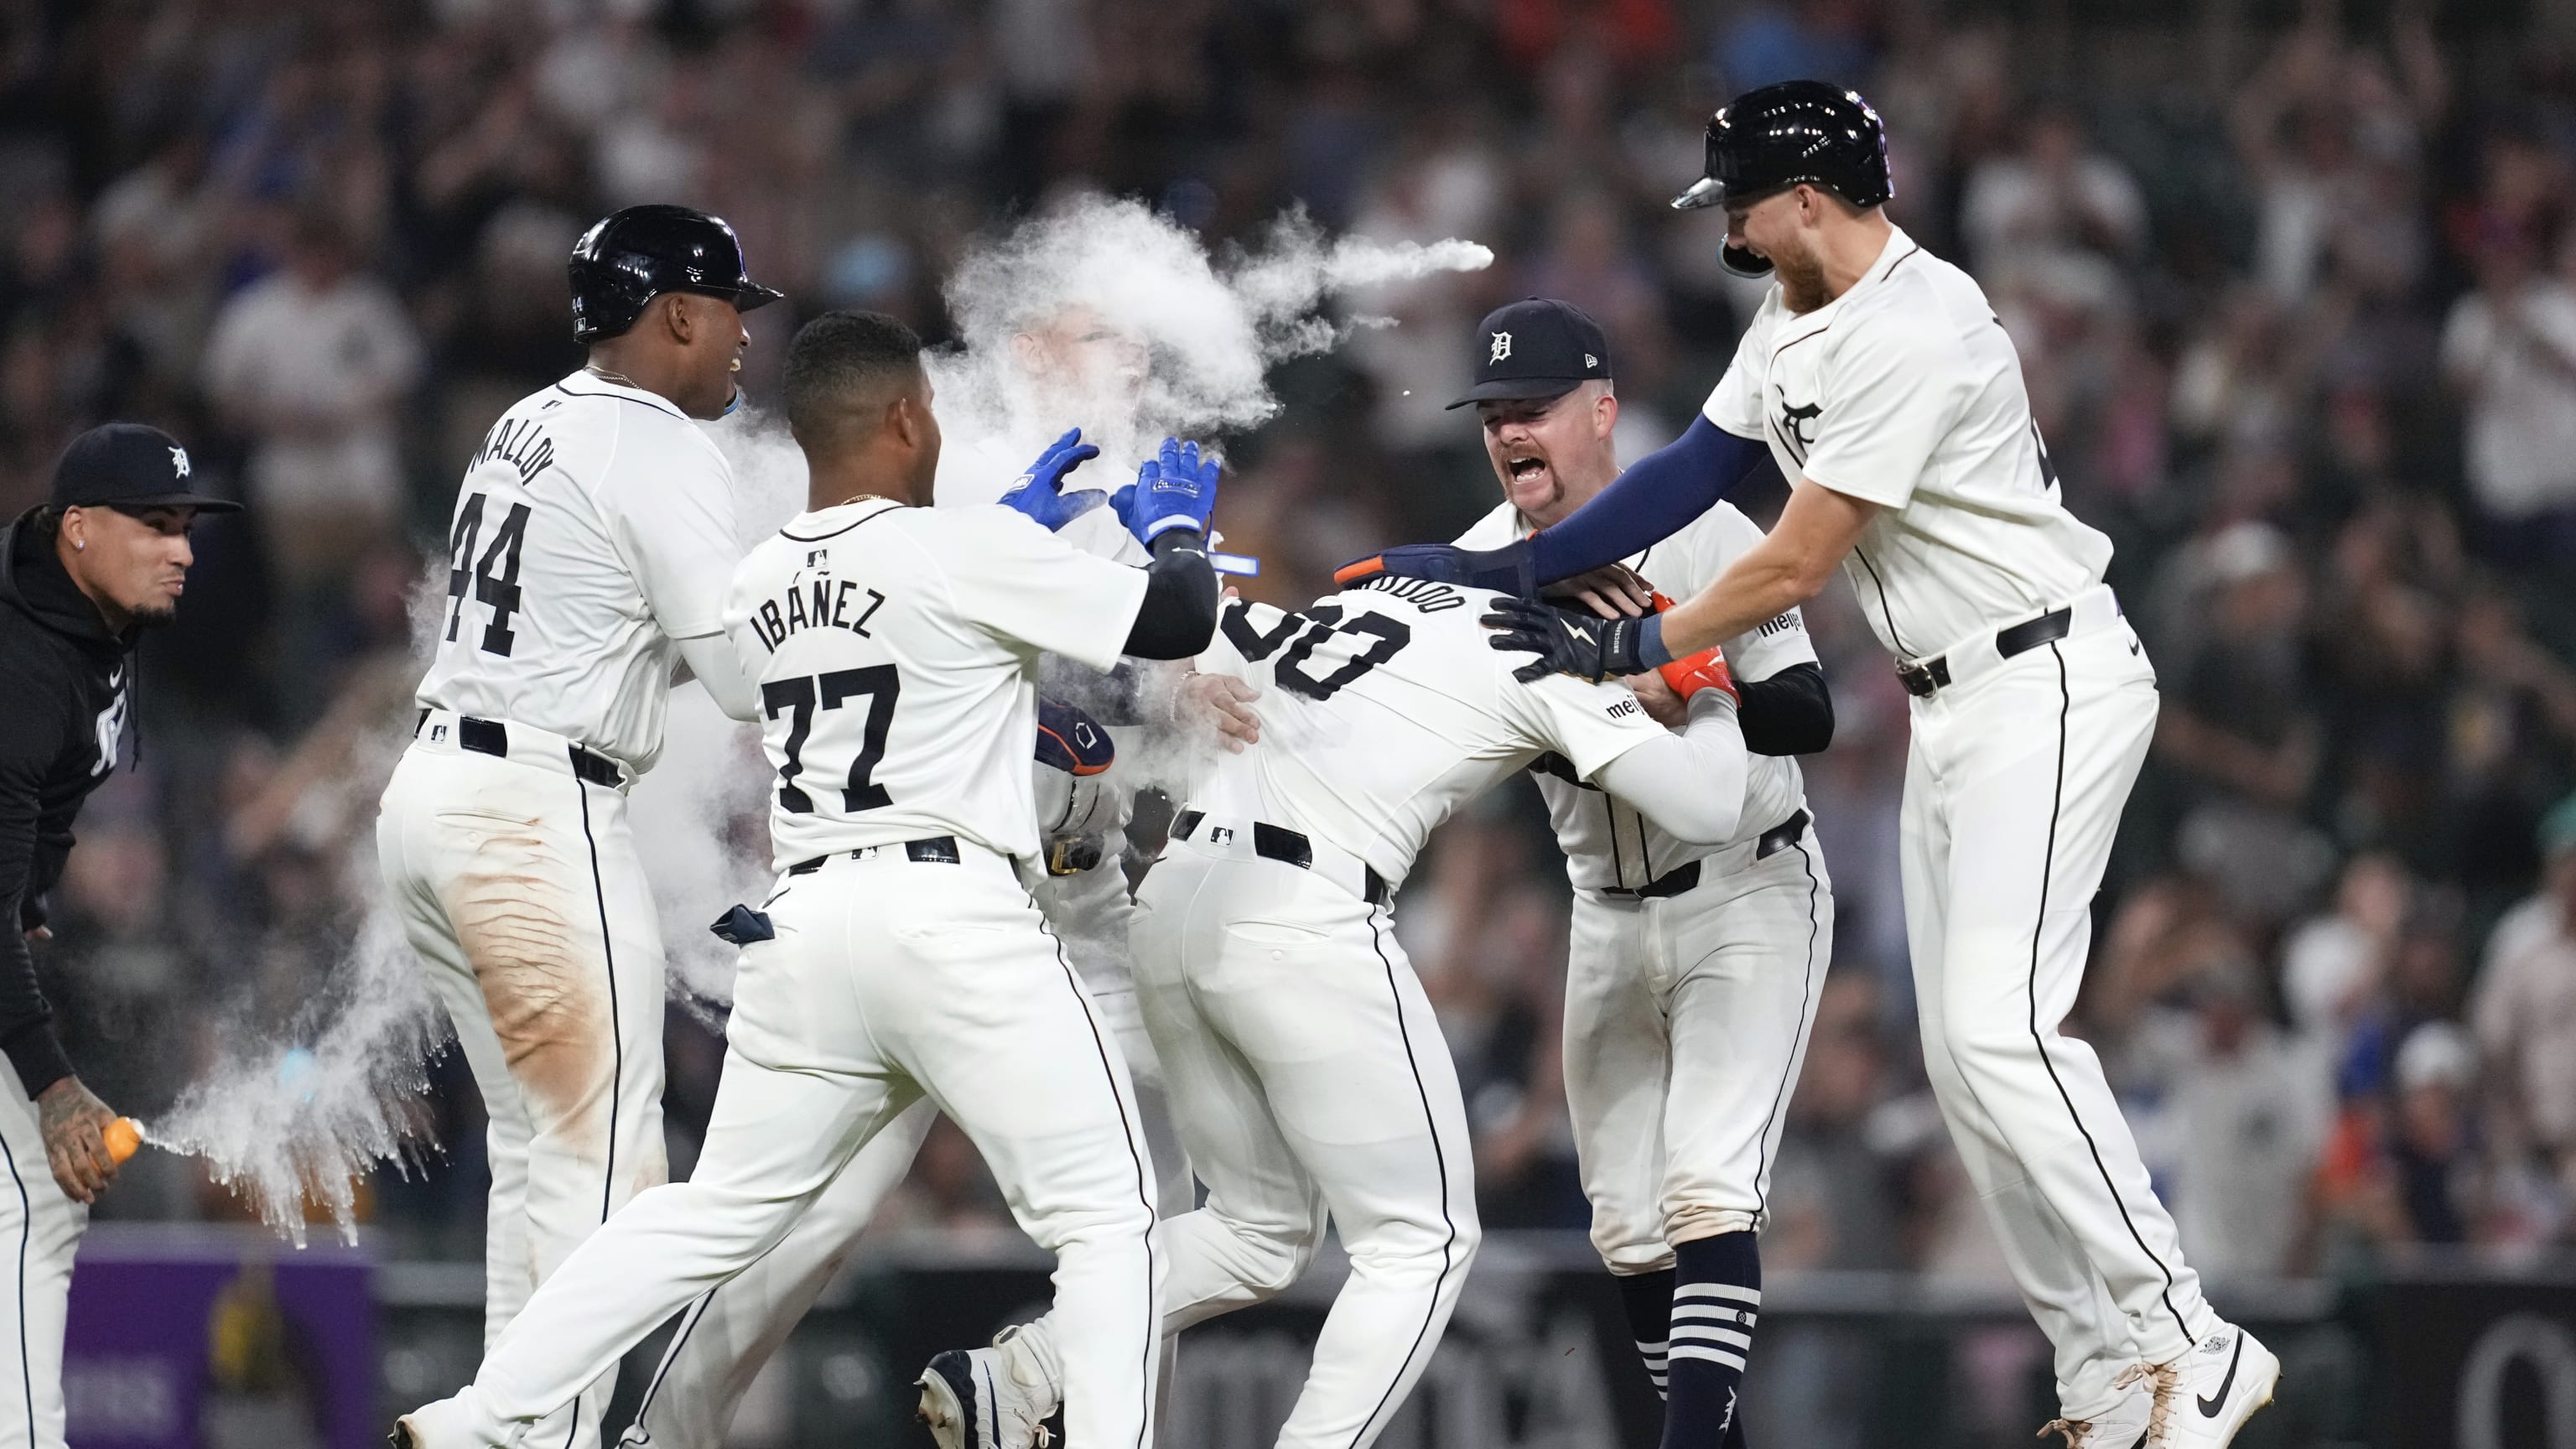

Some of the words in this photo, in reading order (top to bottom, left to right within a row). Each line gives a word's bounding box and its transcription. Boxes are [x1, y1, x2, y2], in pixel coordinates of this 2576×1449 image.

[572, 296, 583, 313] 44
[1489, 331, 1513, 366] D
[168, 446, 190, 479] D
[470, 418, 554, 486] MALLOY
[448, 492, 532, 657] 44
[1352, 575, 1466, 614] DDOO
[750, 570, 886, 655] IBÁÑEZ
[761, 663, 901, 813] 77
